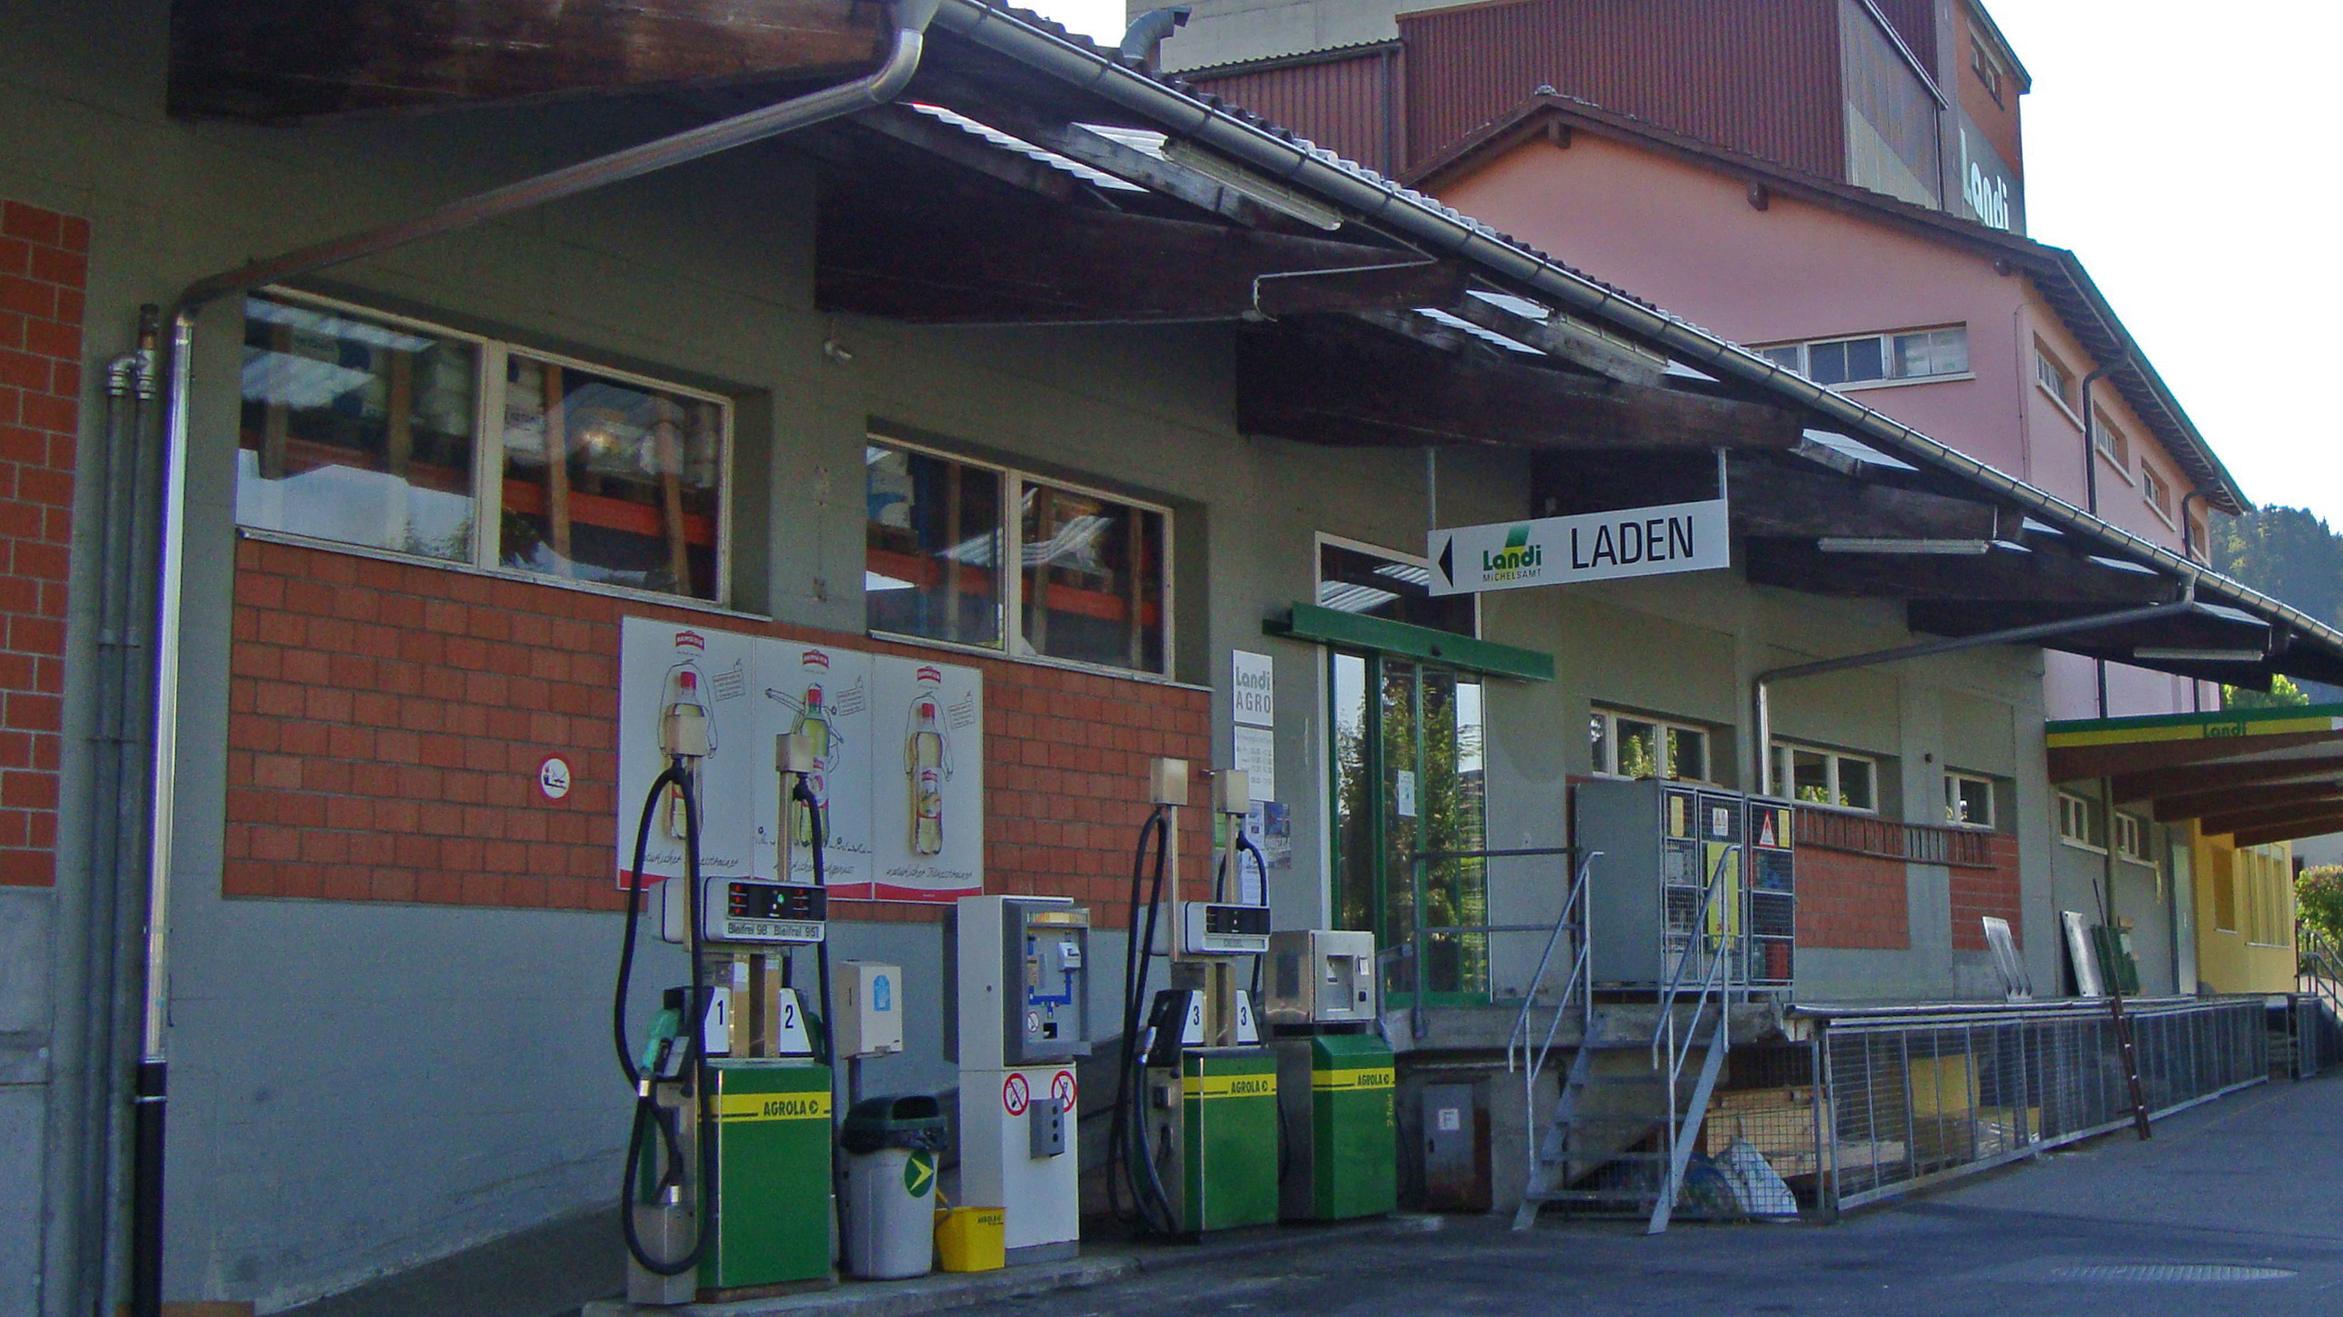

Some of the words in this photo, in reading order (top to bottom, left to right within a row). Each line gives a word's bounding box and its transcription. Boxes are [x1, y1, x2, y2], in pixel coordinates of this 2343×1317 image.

[1960, 128, 2009, 231] Landi
[1570, 515, 1694, 570] LADEN
[1483, 544, 1542, 571] Landi
[1236, 666, 1271, 692] Landi
[1236, 691, 1271, 713] AGRO
[2203, 721, 2247, 738] Landi
[717, 1000, 724, 1026] 1
[785, 1004, 794, 1029] 2
[1193, 1005, 1200, 1025] 3
[1240, 1006, 1247, 1026] 3
[1231, 1081, 1260, 1093] AGROLA
[1357, 1074, 1383, 1086] AGROLA
[764, 1100, 807, 1117] AGROLA
